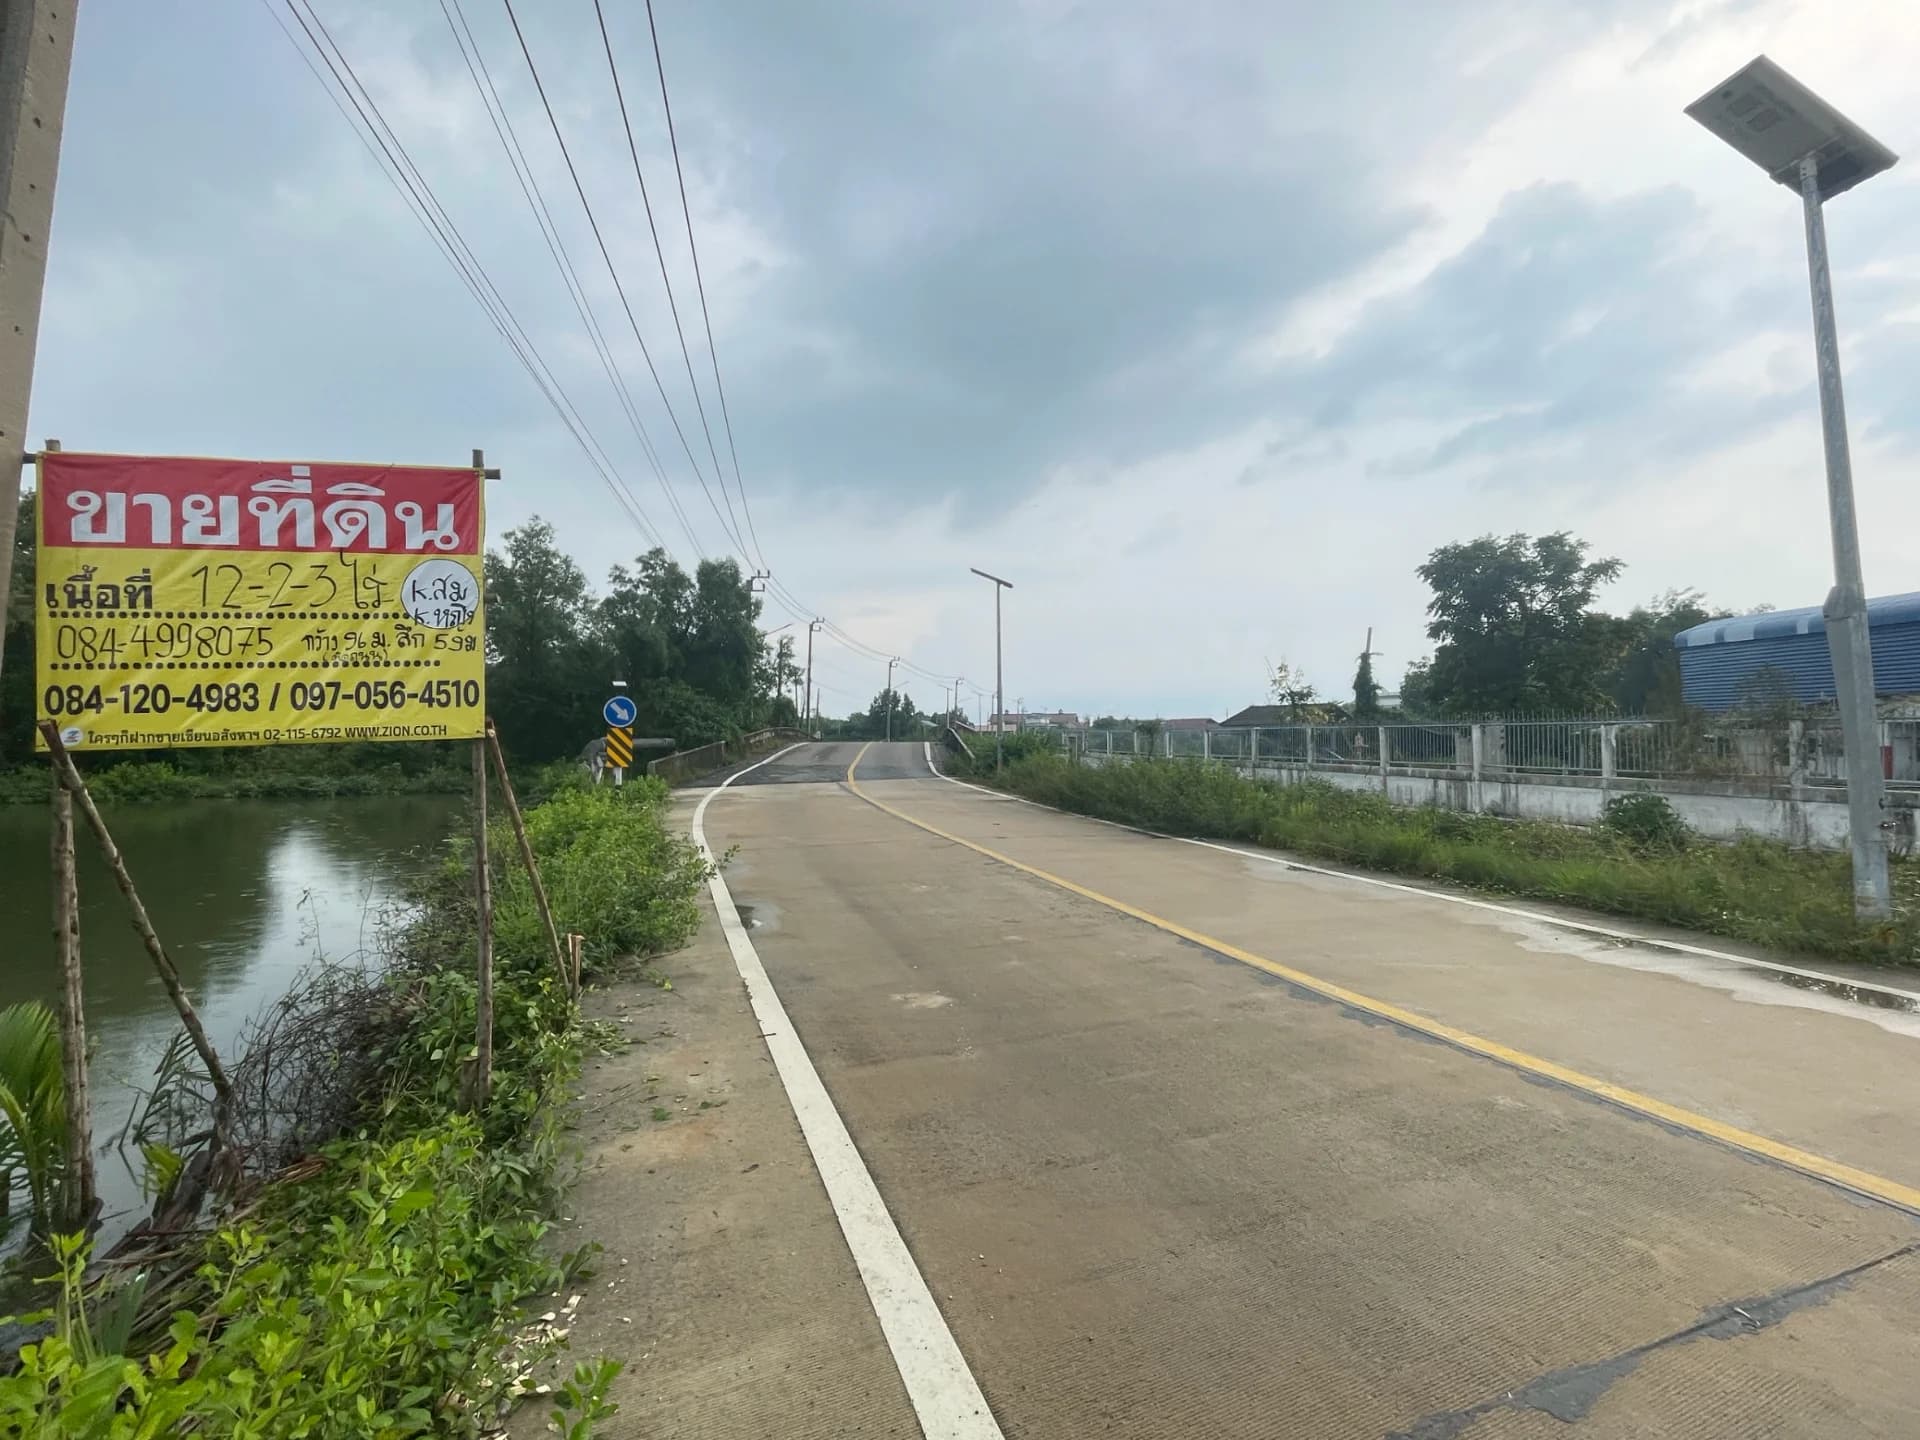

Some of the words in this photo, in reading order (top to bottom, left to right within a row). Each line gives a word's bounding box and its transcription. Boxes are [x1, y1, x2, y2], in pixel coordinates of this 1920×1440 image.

[66, 465, 460, 550] ขายที่ดิน
[46, 564, 153, 609] เนื้อที่
[57, 622, 273, 663] 084-4998075
[44, 683, 260, 715] 084-120-4983
[268, 682, 281, 711] /
[290, 680, 480, 711] 097-056-4510
[263, 728, 342, 741] 02-115-6792
[344, 725, 447, 739] WWW.ZION.CO.TH
